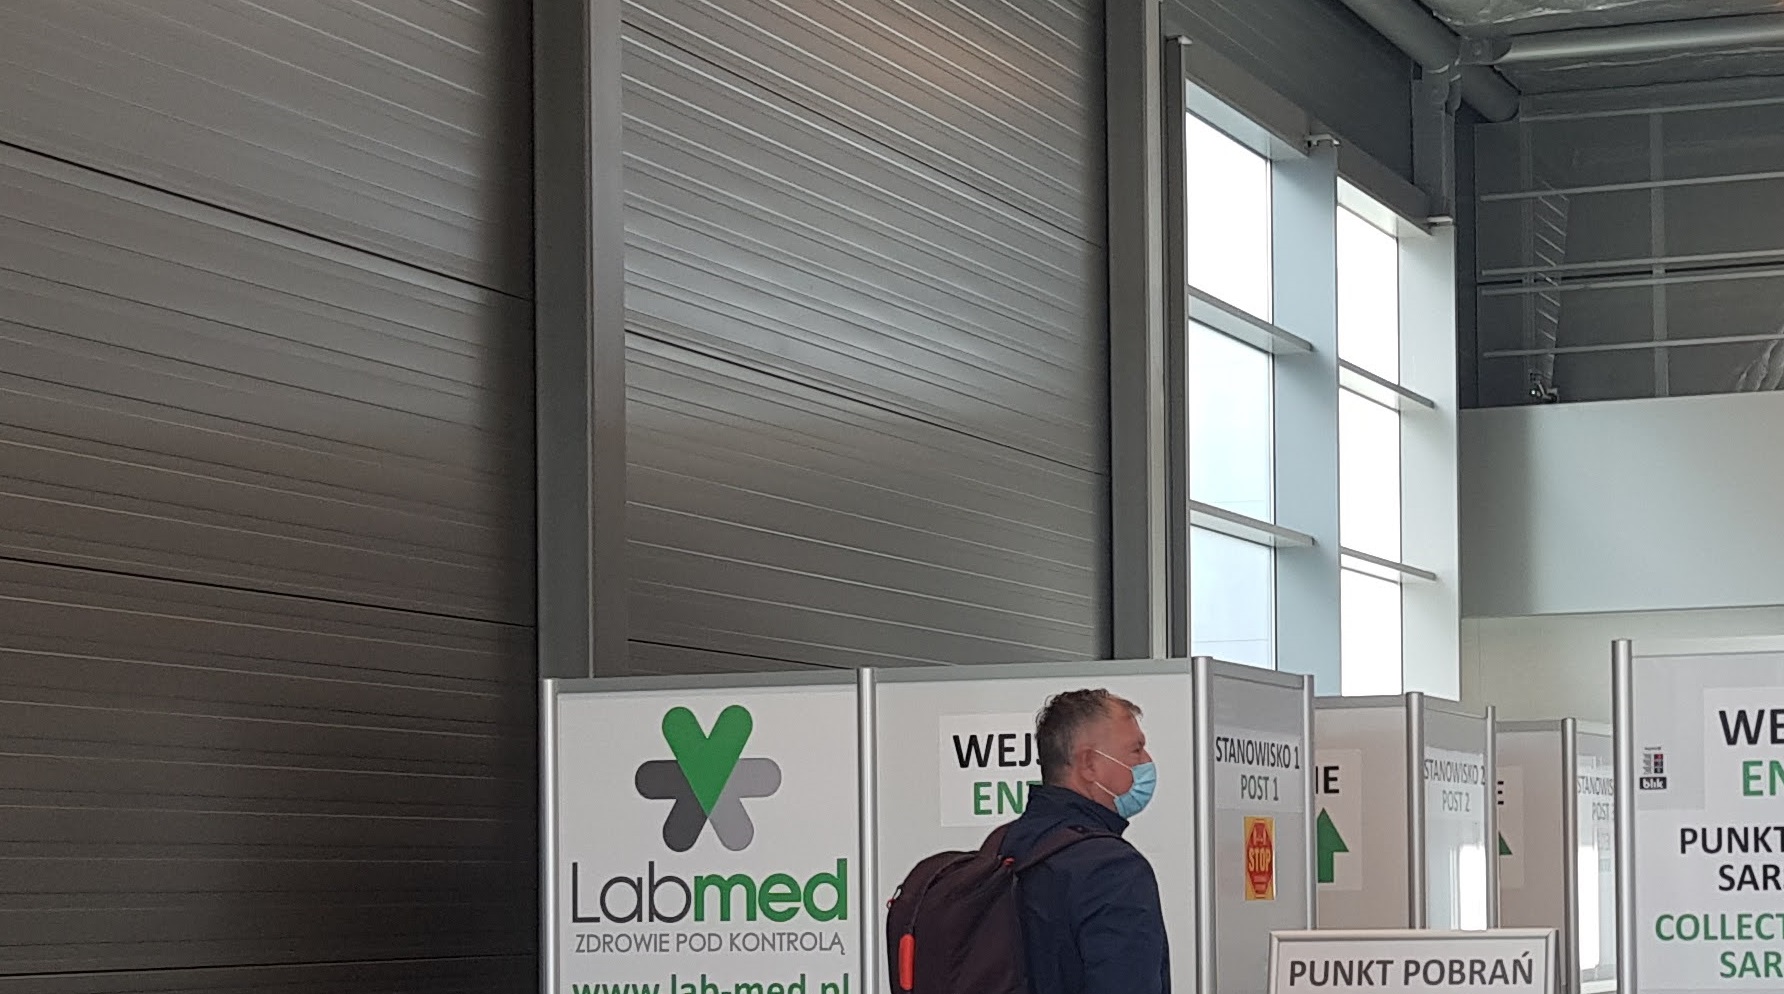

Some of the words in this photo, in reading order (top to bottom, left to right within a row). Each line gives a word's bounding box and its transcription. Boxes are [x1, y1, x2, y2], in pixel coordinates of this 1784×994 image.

[1215, 736, 1292, 769] STANOWISKO
[1294, 745, 1301, 770] 1
[1424, 759, 1478, 785] STANOWISKO
[1480, 764, 1486, 786] 2
[1240, 774, 1270, 801] POST
[1272, 777, 1279, 802] 1
[1442, 790, 1464, 812] POST
[1465, 791, 1471, 813] 2
[1248, 847, 1271, 872] STOP
[571, 857, 848, 924] Labmed
[575, 933, 670, 954] ZDROWIE
[676, 932, 723, 953] POD
[729, 931, 846, 956] KONTROLĄ
[1289, 959, 1395, 987] PUNKT
[1403, 950, 1533, 986] POBRAŃ
